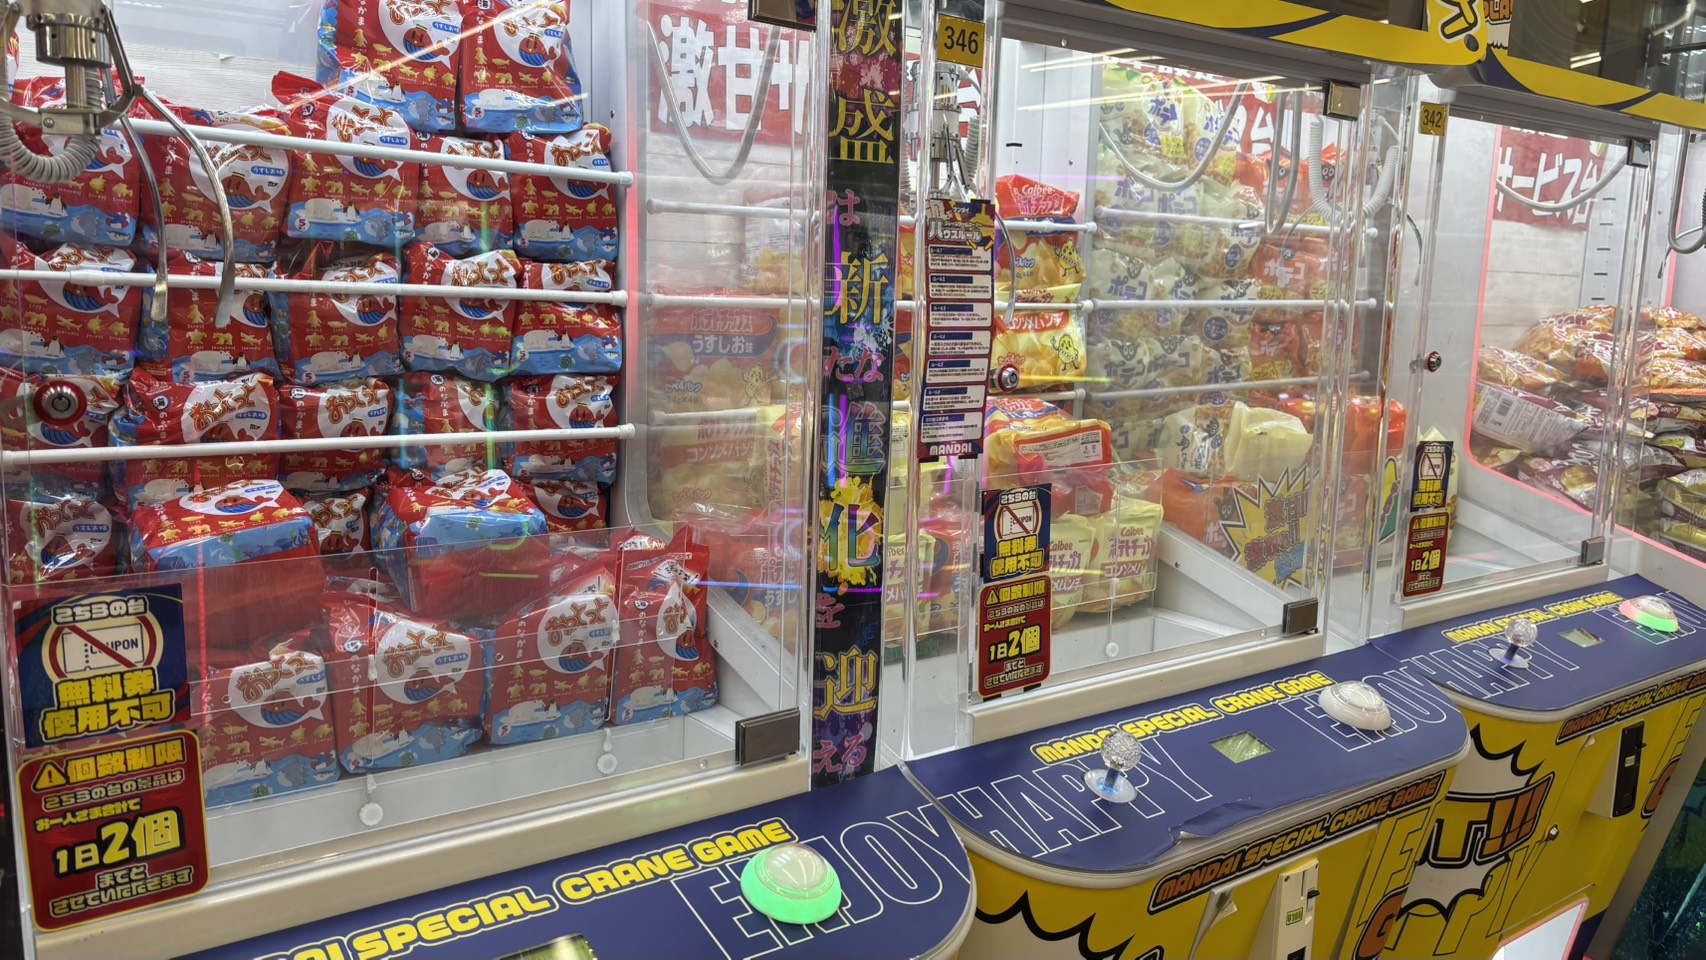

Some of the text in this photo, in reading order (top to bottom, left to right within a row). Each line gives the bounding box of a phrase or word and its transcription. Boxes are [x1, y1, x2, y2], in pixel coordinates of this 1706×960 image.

[943, 25, 979, 55] 346
[1422, 108, 1442, 129] 342
[253, 166, 285, 176] うすしお味
[1021, 184, 1054, 196] Calbee
[928, 221, 981, 241] ハウスルール
[692, 335, 754, 354] うすしお味
[188, 382, 258, 433] おっとっと
[325, 387, 381, 425] おっとっと
[929, 442, 972, 456] MANDAI
[1000, 489, 1037, 505] こちらの台
[73, 524, 109, 532] うすしお味
[1120, 526, 1145, 537] Calbee
[990, 550, 1044, 577] 使用不可
[1410, 549, 1441, 572] 1日2個
[55, 598, 147, 622] こちらの台
[543, 597, 611, 648] おっとっと
[90, 637, 139, 655] CUPON
[383, 630, 456, 679] おっとっと
[990, 625, 1041, 661] 1日2個
[57, 669, 156, 709] 無料券
[235, 654, 317, 703] おっとっと
[43, 691, 173, 740] 使用不可
[1036, 673, 1334, 764] MANDA SPECIAL CRANE GAME
[1606, 690, 1656, 717] SPECIAL
[67, 738, 183, 784] 個数制限
[44, 770, 184, 811] こちらの台の景品は
[56, 810, 181, 874] 1日2個
[1157, 776, 1439, 902] MANDAI SPECIAL CRANE GAME
[98, 865, 147, 888] までと
[351, 892, 551, 960] SPECIAL
[560, 847, 694, 900] CRANE
[695, 821, 792, 863] GAME
[52, 869, 193, 915] させていただきます
